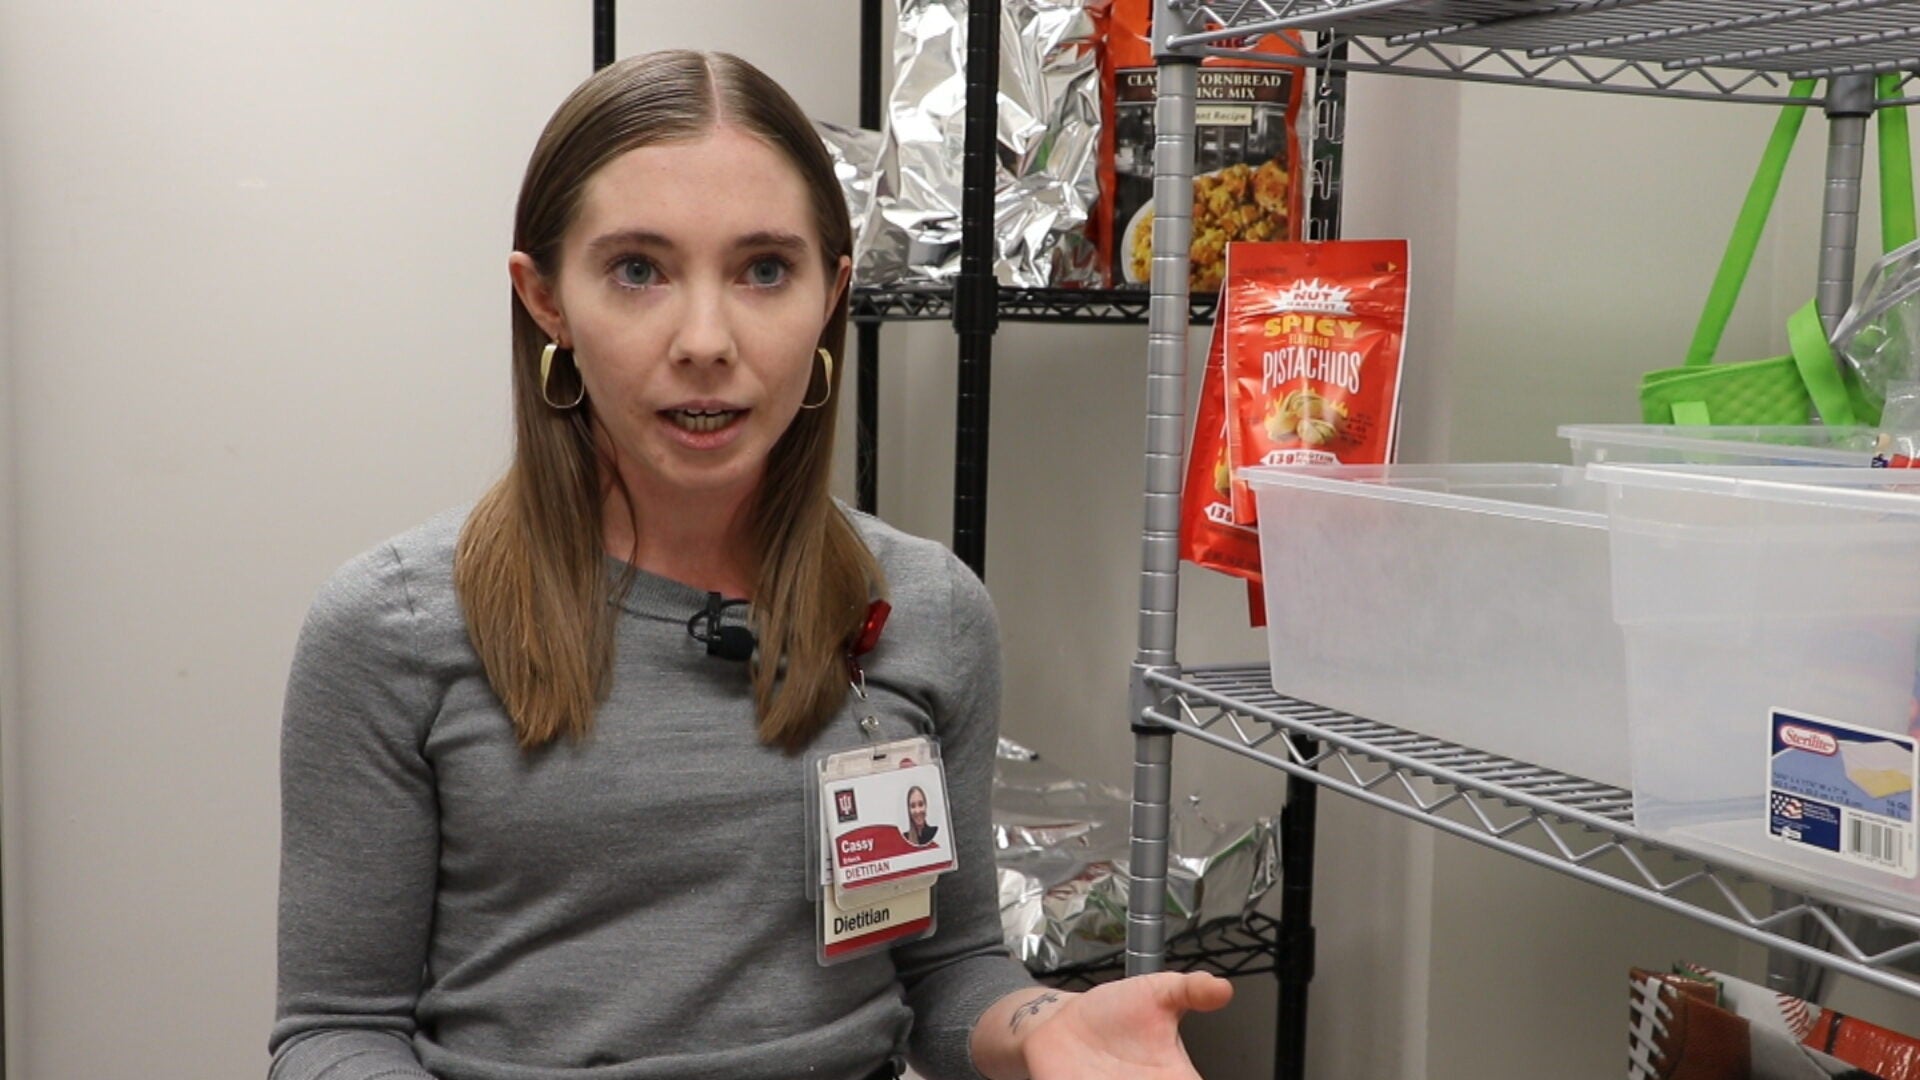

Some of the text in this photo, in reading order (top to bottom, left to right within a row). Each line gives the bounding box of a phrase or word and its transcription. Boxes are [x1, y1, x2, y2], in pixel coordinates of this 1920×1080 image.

[1228, 87, 1256, 99] MIX
[1293, 291, 1333, 302] NUT
[1263, 313, 1362, 339] SPICY
[1261, 346, 1361, 395] PISTACHIOS
[1786, 727, 1830, 751] Sterilite
[841, 838, 874, 853] Cassy
[845, 860, 890, 879] DIETITIAN
[834, 907, 890, 935] Dietitian
